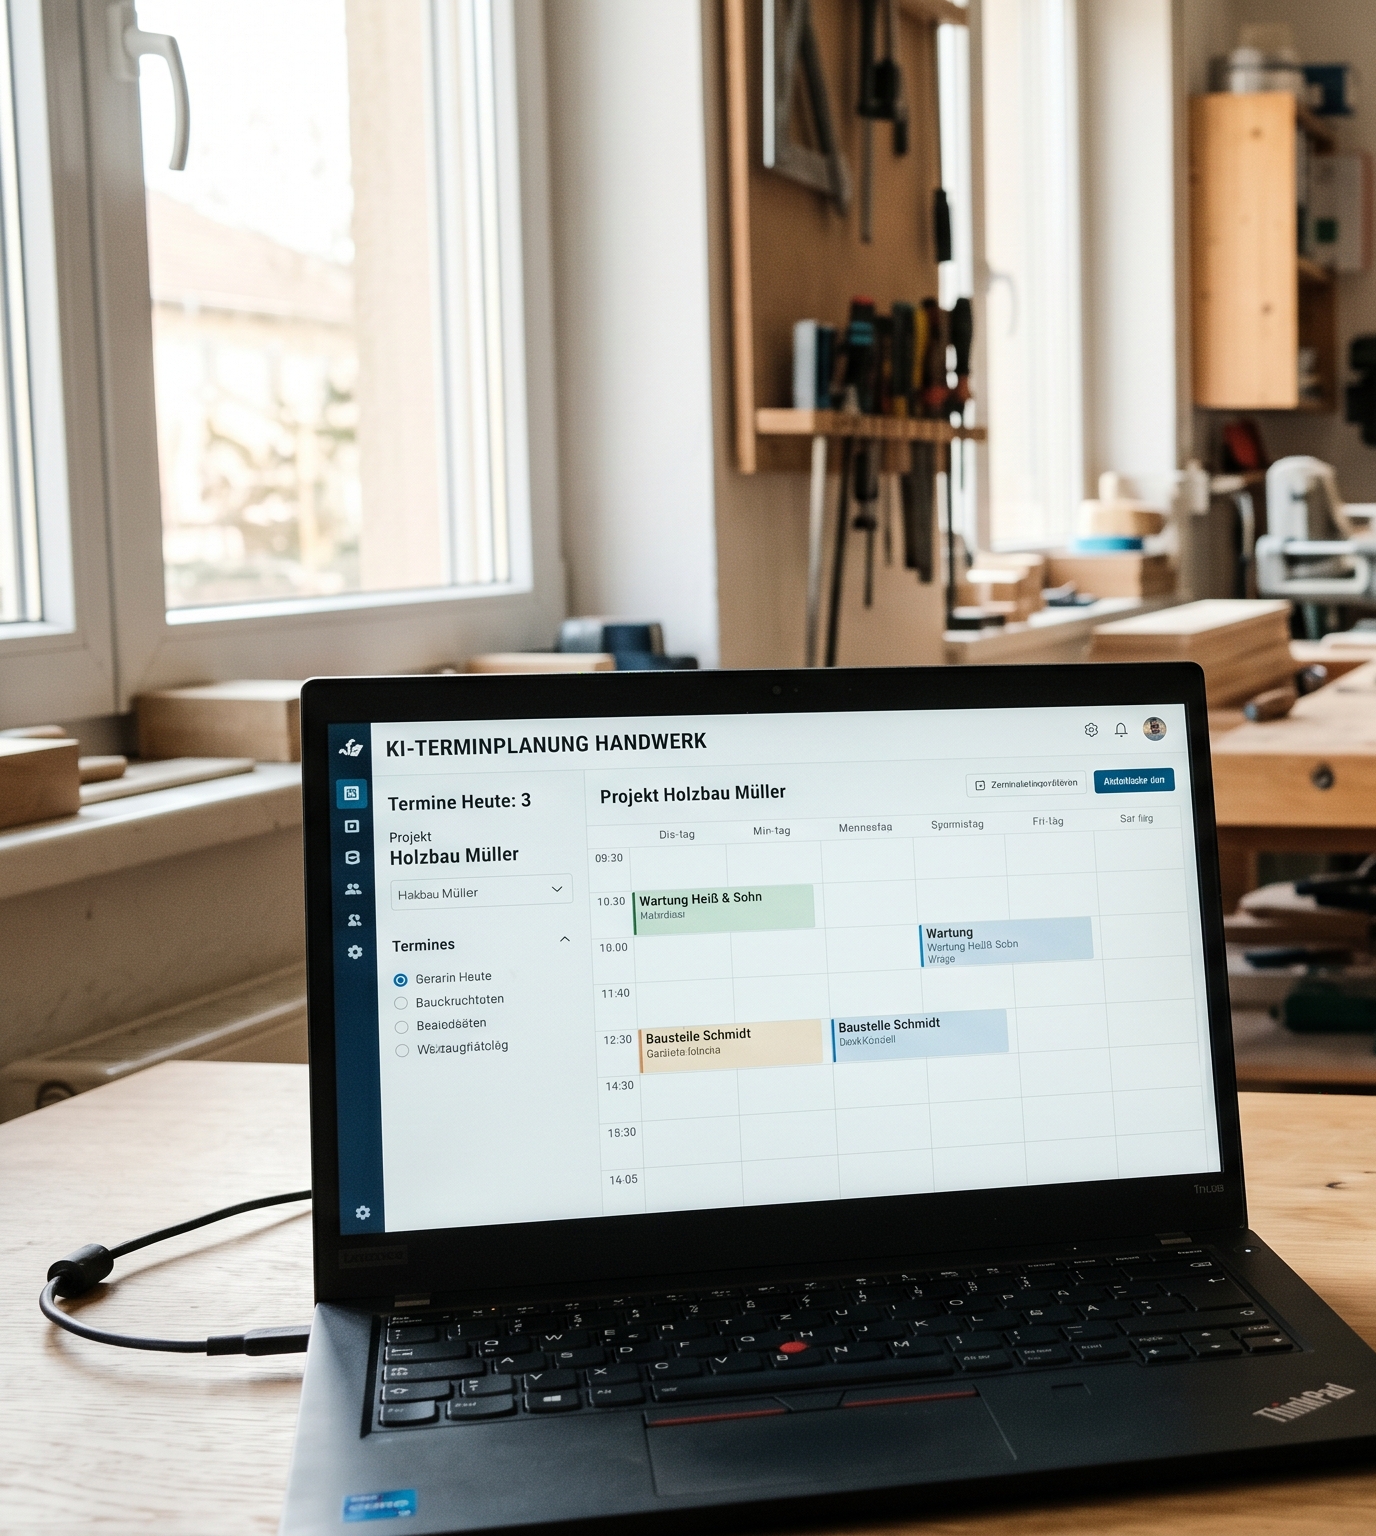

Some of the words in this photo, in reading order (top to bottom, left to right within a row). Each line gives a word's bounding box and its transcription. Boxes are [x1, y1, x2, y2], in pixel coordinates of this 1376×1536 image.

[387, 736, 588, 757] KI-TERMINPLANUNG
[596, 733, 707, 751] HANDWERK
[601, 788, 659, 807] Projekt
[664, 786, 729, 801] Holzbau
[736, 784, 786, 799] Müller
[388, 795, 456, 811] Termine
[462, 795, 515, 808] Heute:
[522, 793, 531, 807] 3
[390, 831, 431, 845] Projekt
[660, 830, 694, 840] Dis-tag
[391, 849, 459, 865] Holzbau
[466, 846, 518, 862] Müller
[595, 853, 623, 862] 09:30
[399, 890, 439, 900] Hakbau
[443, 888, 478, 898] Müller
[640, 896, 688, 907] Wartung
[692, 893, 718, 904] Heiß
[722, 893, 730, 903] &
[734, 892, 762, 902] Sohn
[926, 929, 973, 939] Wartung
[392, 939, 454, 952] Termines
[459, 972, 491, 982] Heute
[602, 988, 629, 998] 11:40
[839, 1020, 890, 1033] Baustelle
[894, 1017, 940, 1029] Schmidt
[604, 1035, 632, 1044] 12:30
[704, 1028, 751, 1040] Schmidt
[606, 1081, 633, 1090] 14:30
[1252, 1382, 1356, 1423] ThinkPad
